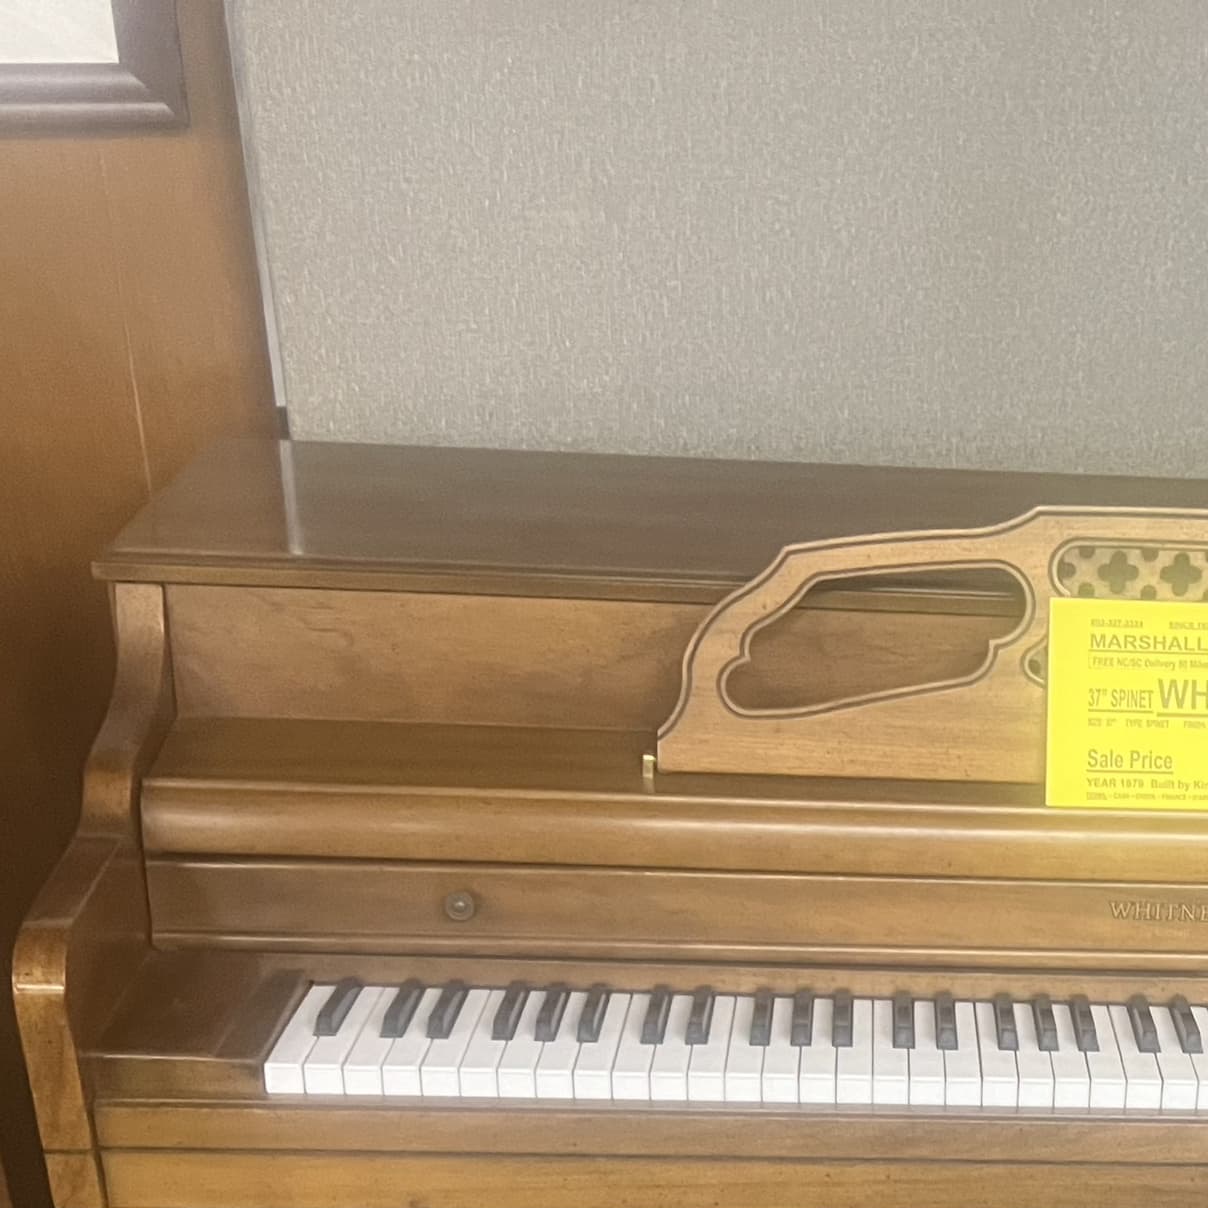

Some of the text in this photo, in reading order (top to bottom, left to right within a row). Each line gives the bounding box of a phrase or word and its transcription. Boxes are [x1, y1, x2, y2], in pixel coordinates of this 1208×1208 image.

[1090, 633, 1208, 651] MARSHALL
[1110, 688, 1154, 709] SPINET
[1087, 748, 1173, 770] Sale Price
[1086, 777, 1117, 788] YEAR
[1177, 779, 1191, 792] by
